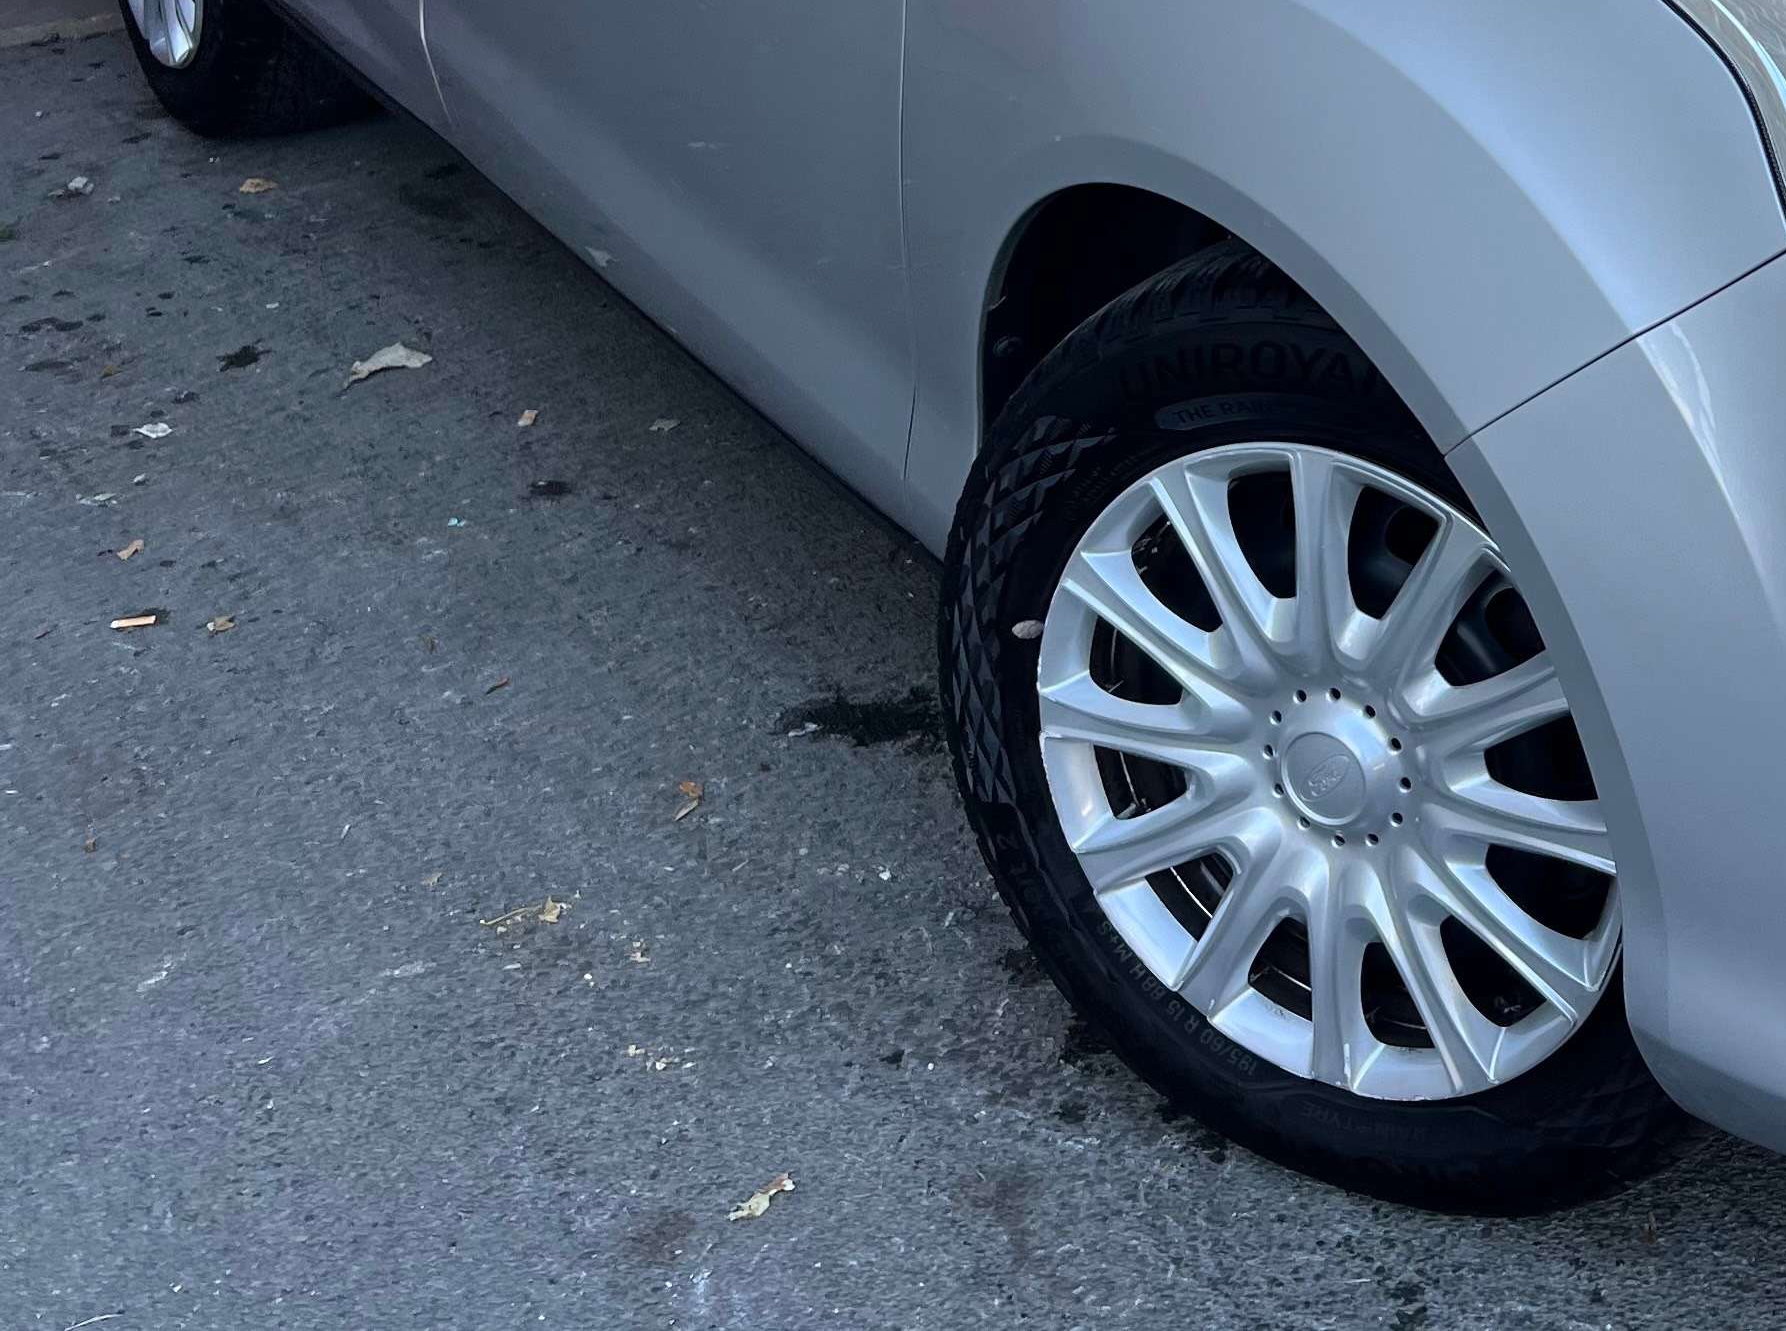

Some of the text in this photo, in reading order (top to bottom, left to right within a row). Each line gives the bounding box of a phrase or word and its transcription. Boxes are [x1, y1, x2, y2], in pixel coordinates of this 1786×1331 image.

[1173, 403, 1216, 423] THE
[1183, 1015, 1201, 1035] R
[1200, 1027, 1258, 1076] 195/60
